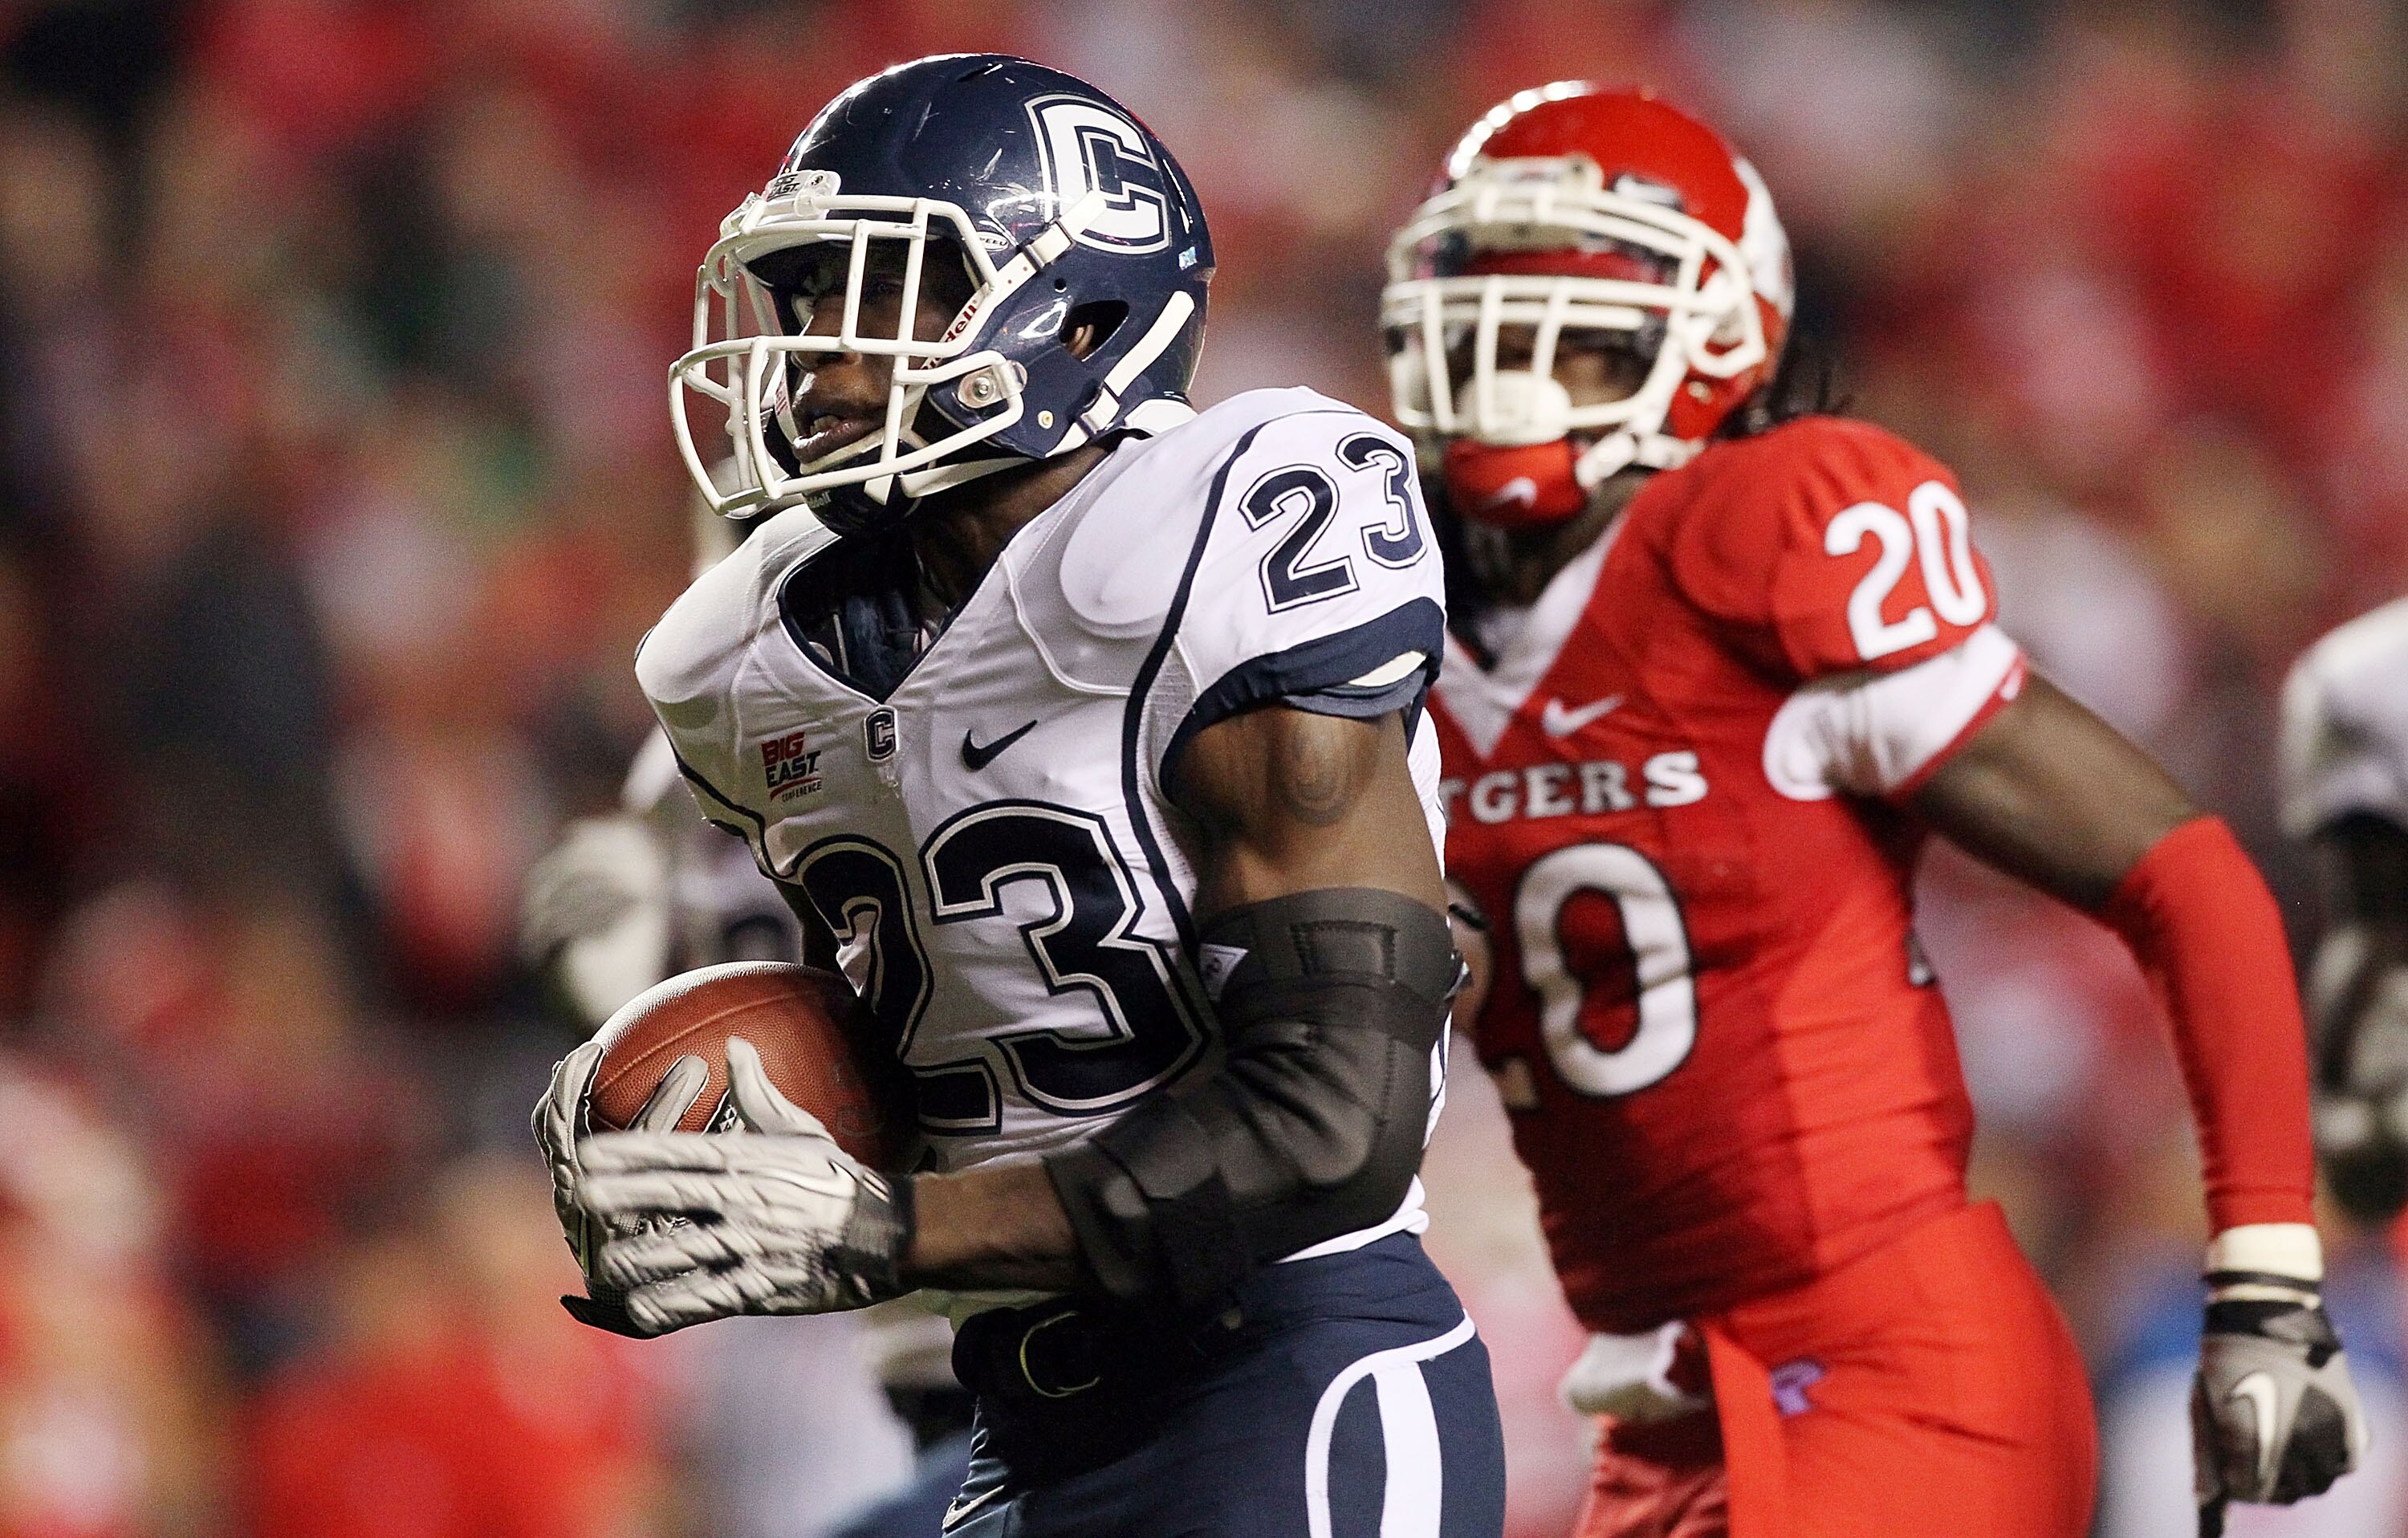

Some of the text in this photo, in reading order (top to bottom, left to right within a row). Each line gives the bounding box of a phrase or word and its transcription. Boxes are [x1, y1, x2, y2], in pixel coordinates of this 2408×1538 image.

[1023, 93, 1170, 255] C
[1238, 431, 1428, 615] 23
[1824, 480, 1986, 661] 20
[762, 731, 805, 767] BIG
[765, 750, 821, 789] EAST
[864, 707, 897, 761] C
[782, 781, 823, 803] CONFERENCE
[795, 799, 1211, 1135] 23
